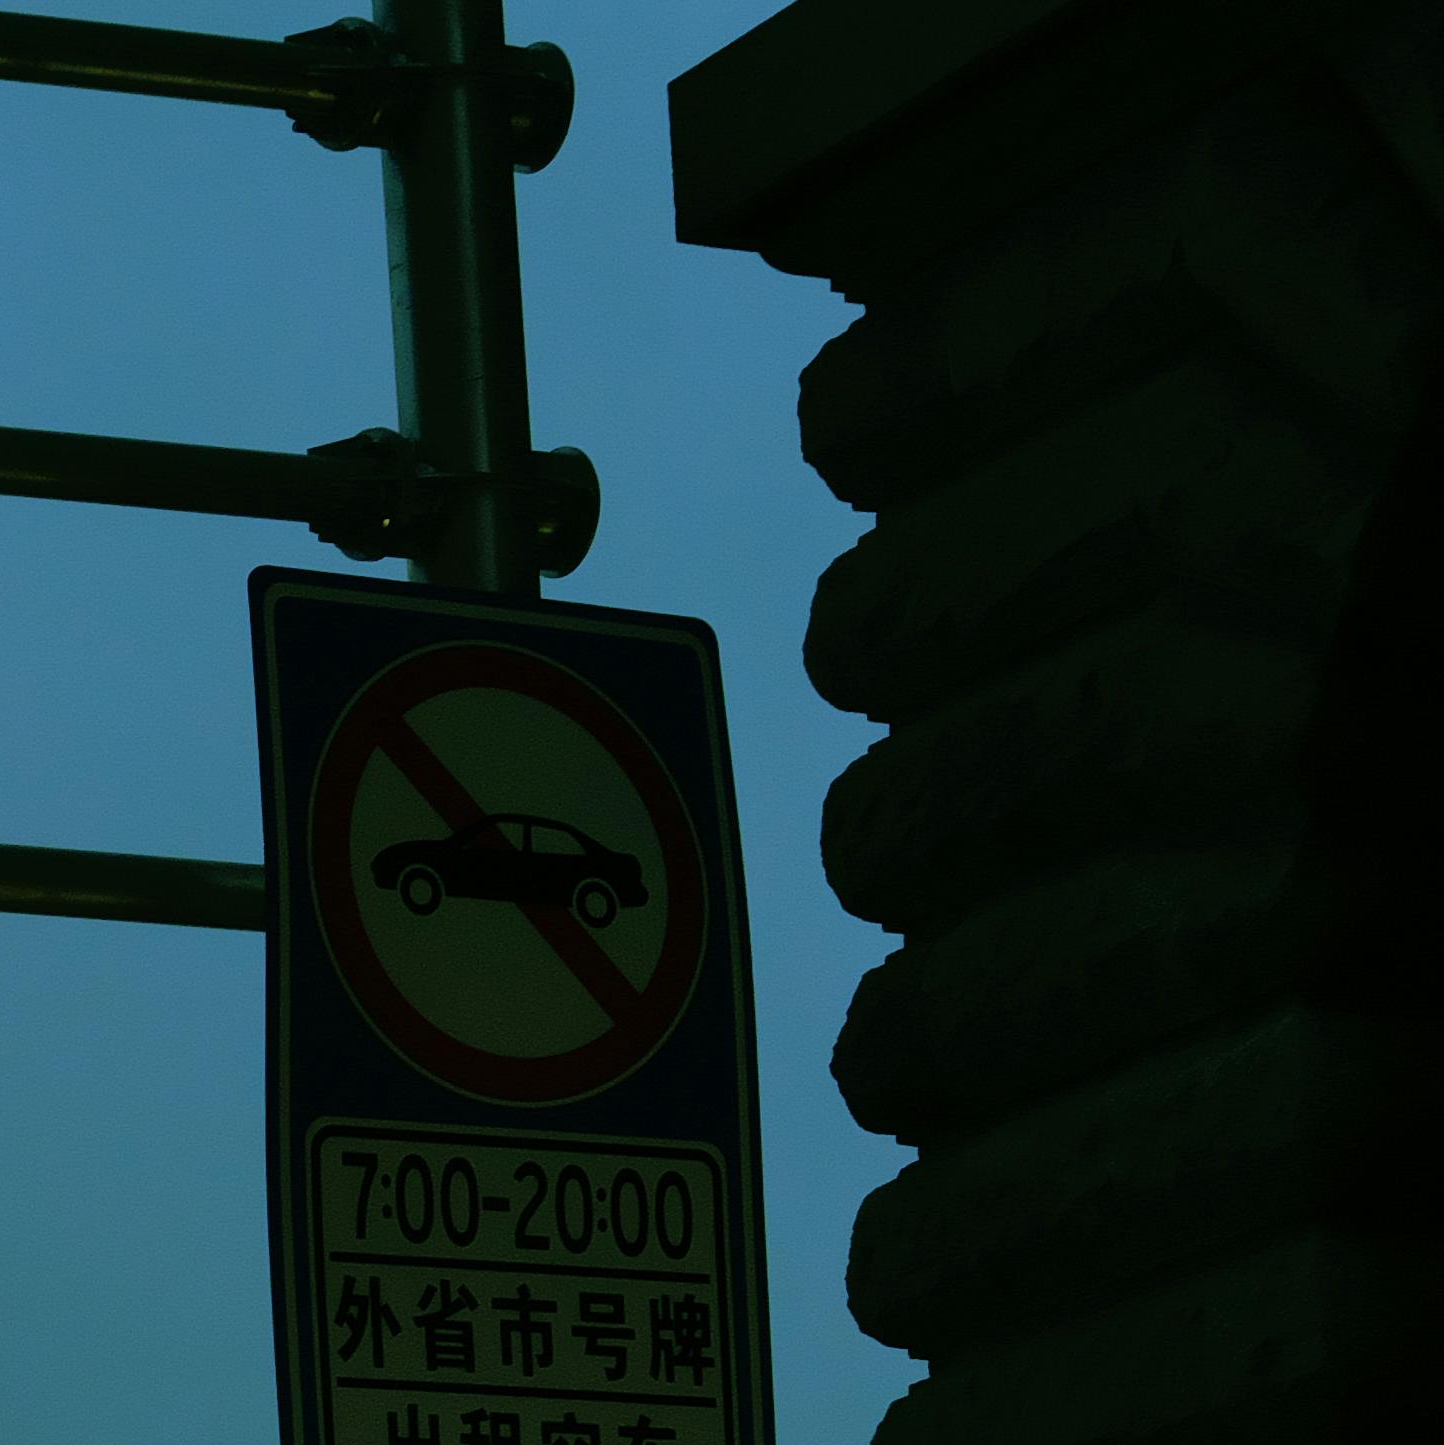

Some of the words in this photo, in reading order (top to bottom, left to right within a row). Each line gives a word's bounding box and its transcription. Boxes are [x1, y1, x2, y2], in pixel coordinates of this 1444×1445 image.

[341, 1151, 693, 1261] 7:00-20:00
[334, 1274, 716, 1387] 外省市号牌
